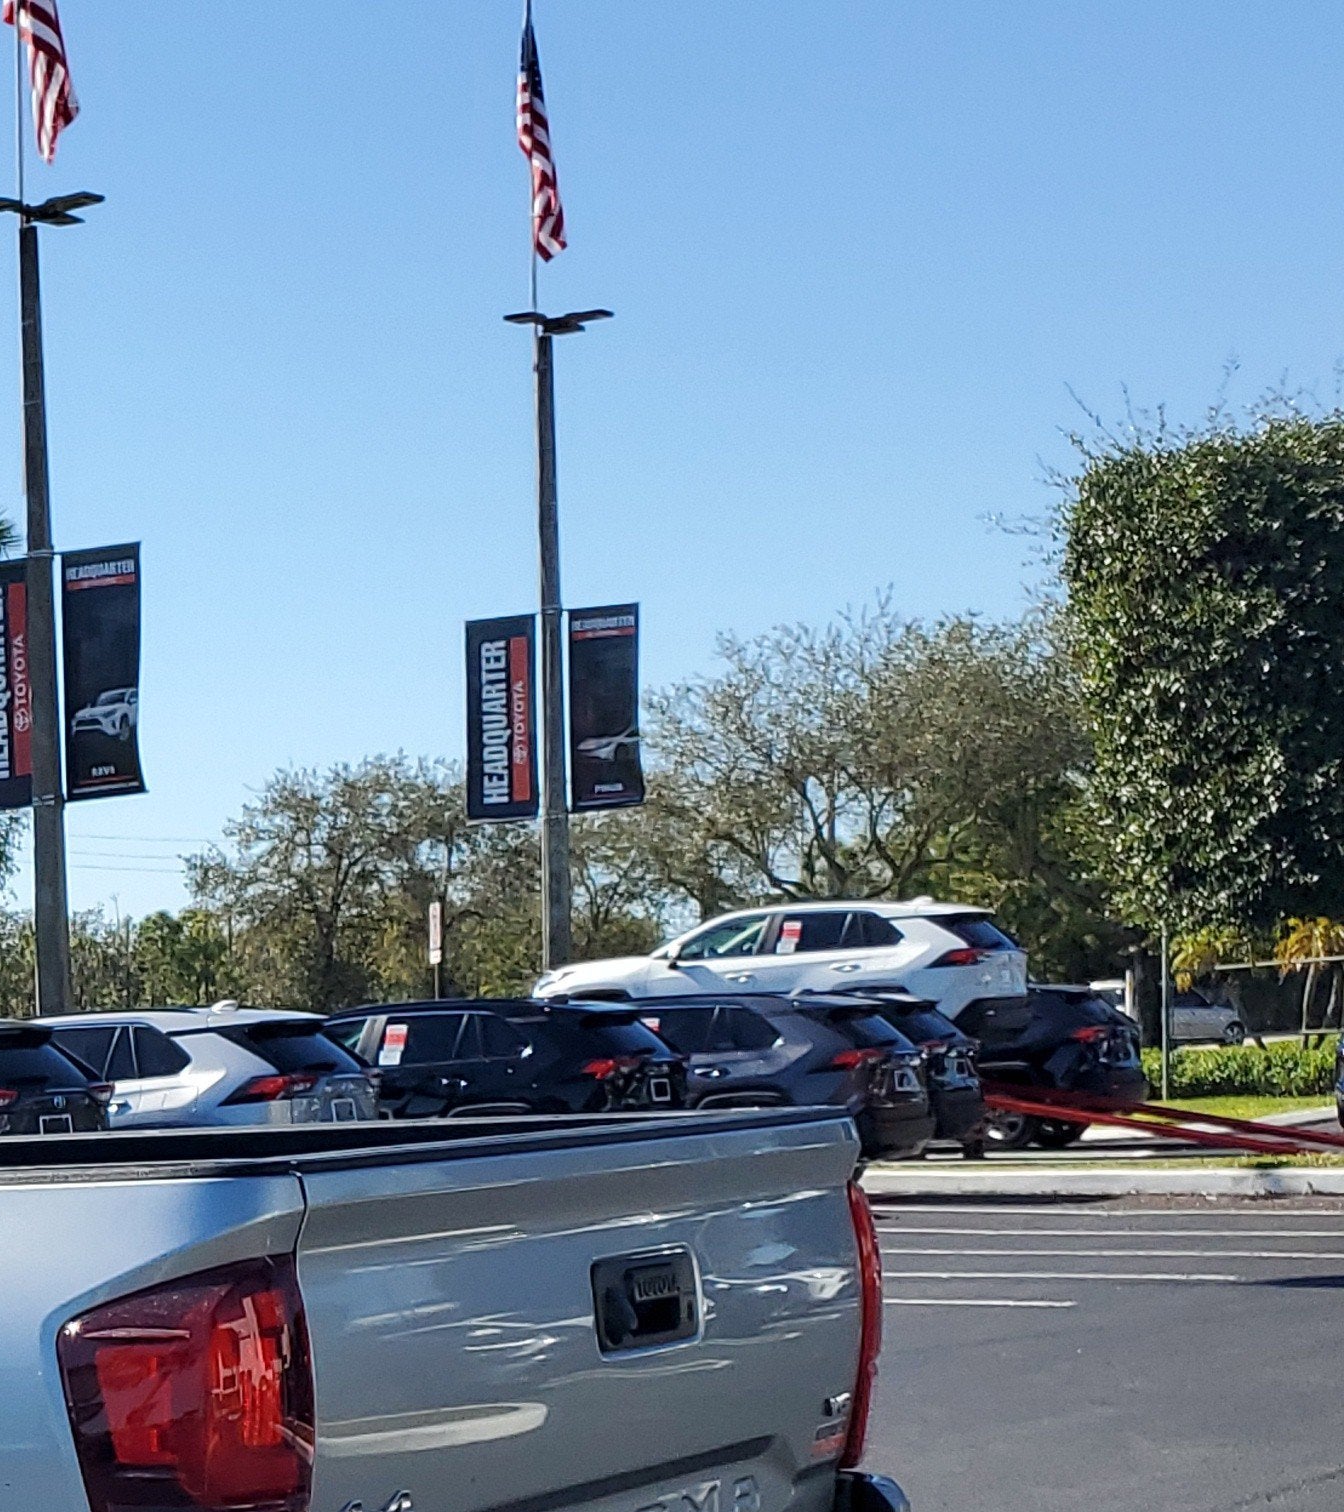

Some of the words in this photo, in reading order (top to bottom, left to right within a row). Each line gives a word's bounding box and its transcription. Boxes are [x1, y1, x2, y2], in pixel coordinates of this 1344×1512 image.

[12, 634, 27, 708] TOYOTA
[480, 639, 511, 805] HEADQUARTER
[513, 680, 527, 742] TOYOTA
